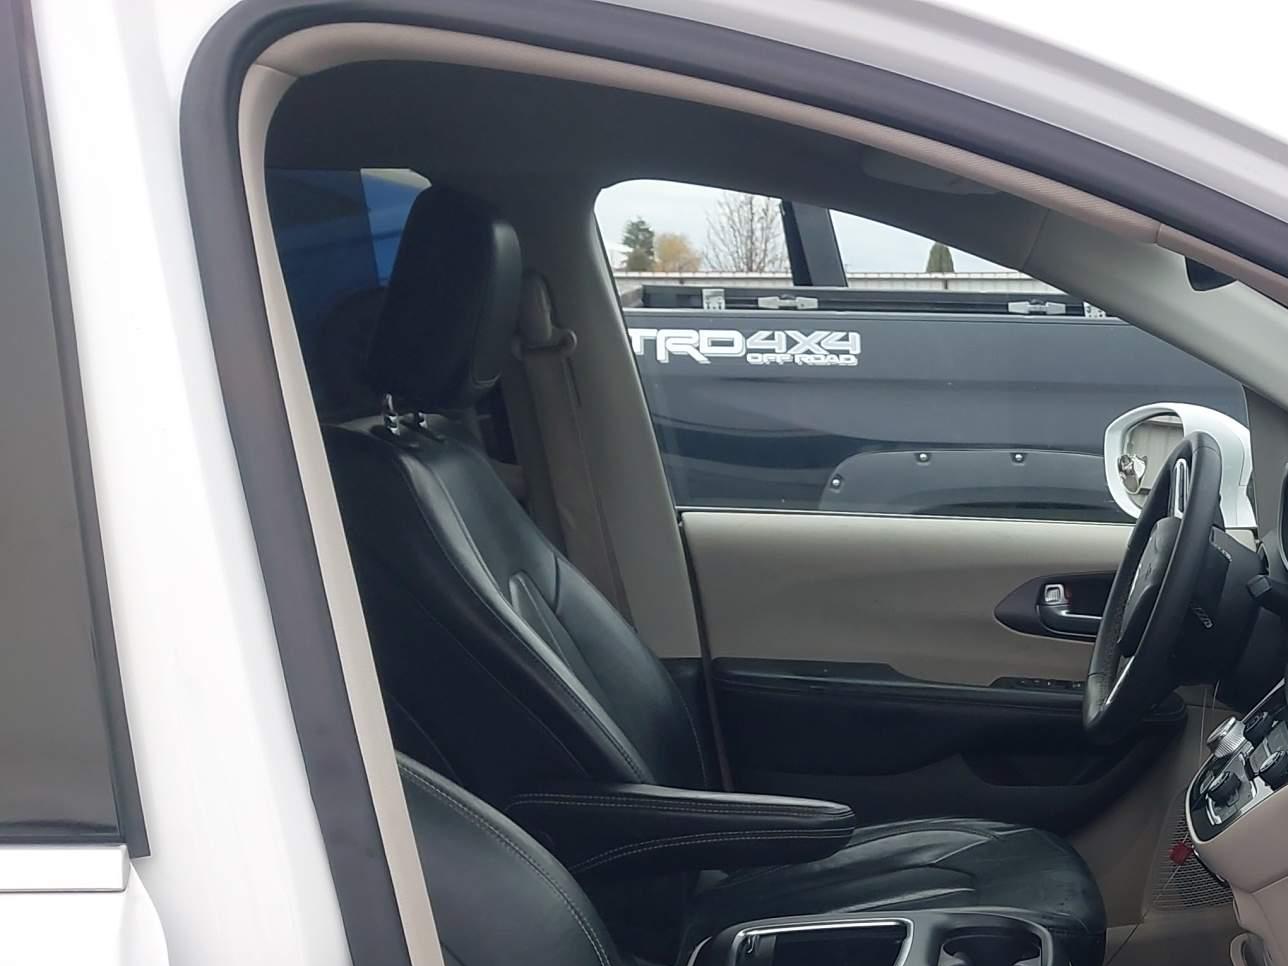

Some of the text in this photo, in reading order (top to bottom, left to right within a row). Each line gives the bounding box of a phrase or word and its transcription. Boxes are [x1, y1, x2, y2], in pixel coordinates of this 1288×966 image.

[628, 328, 861, 364] TRD 4X4
[747, 353, 858, 366] OFF ROAD
